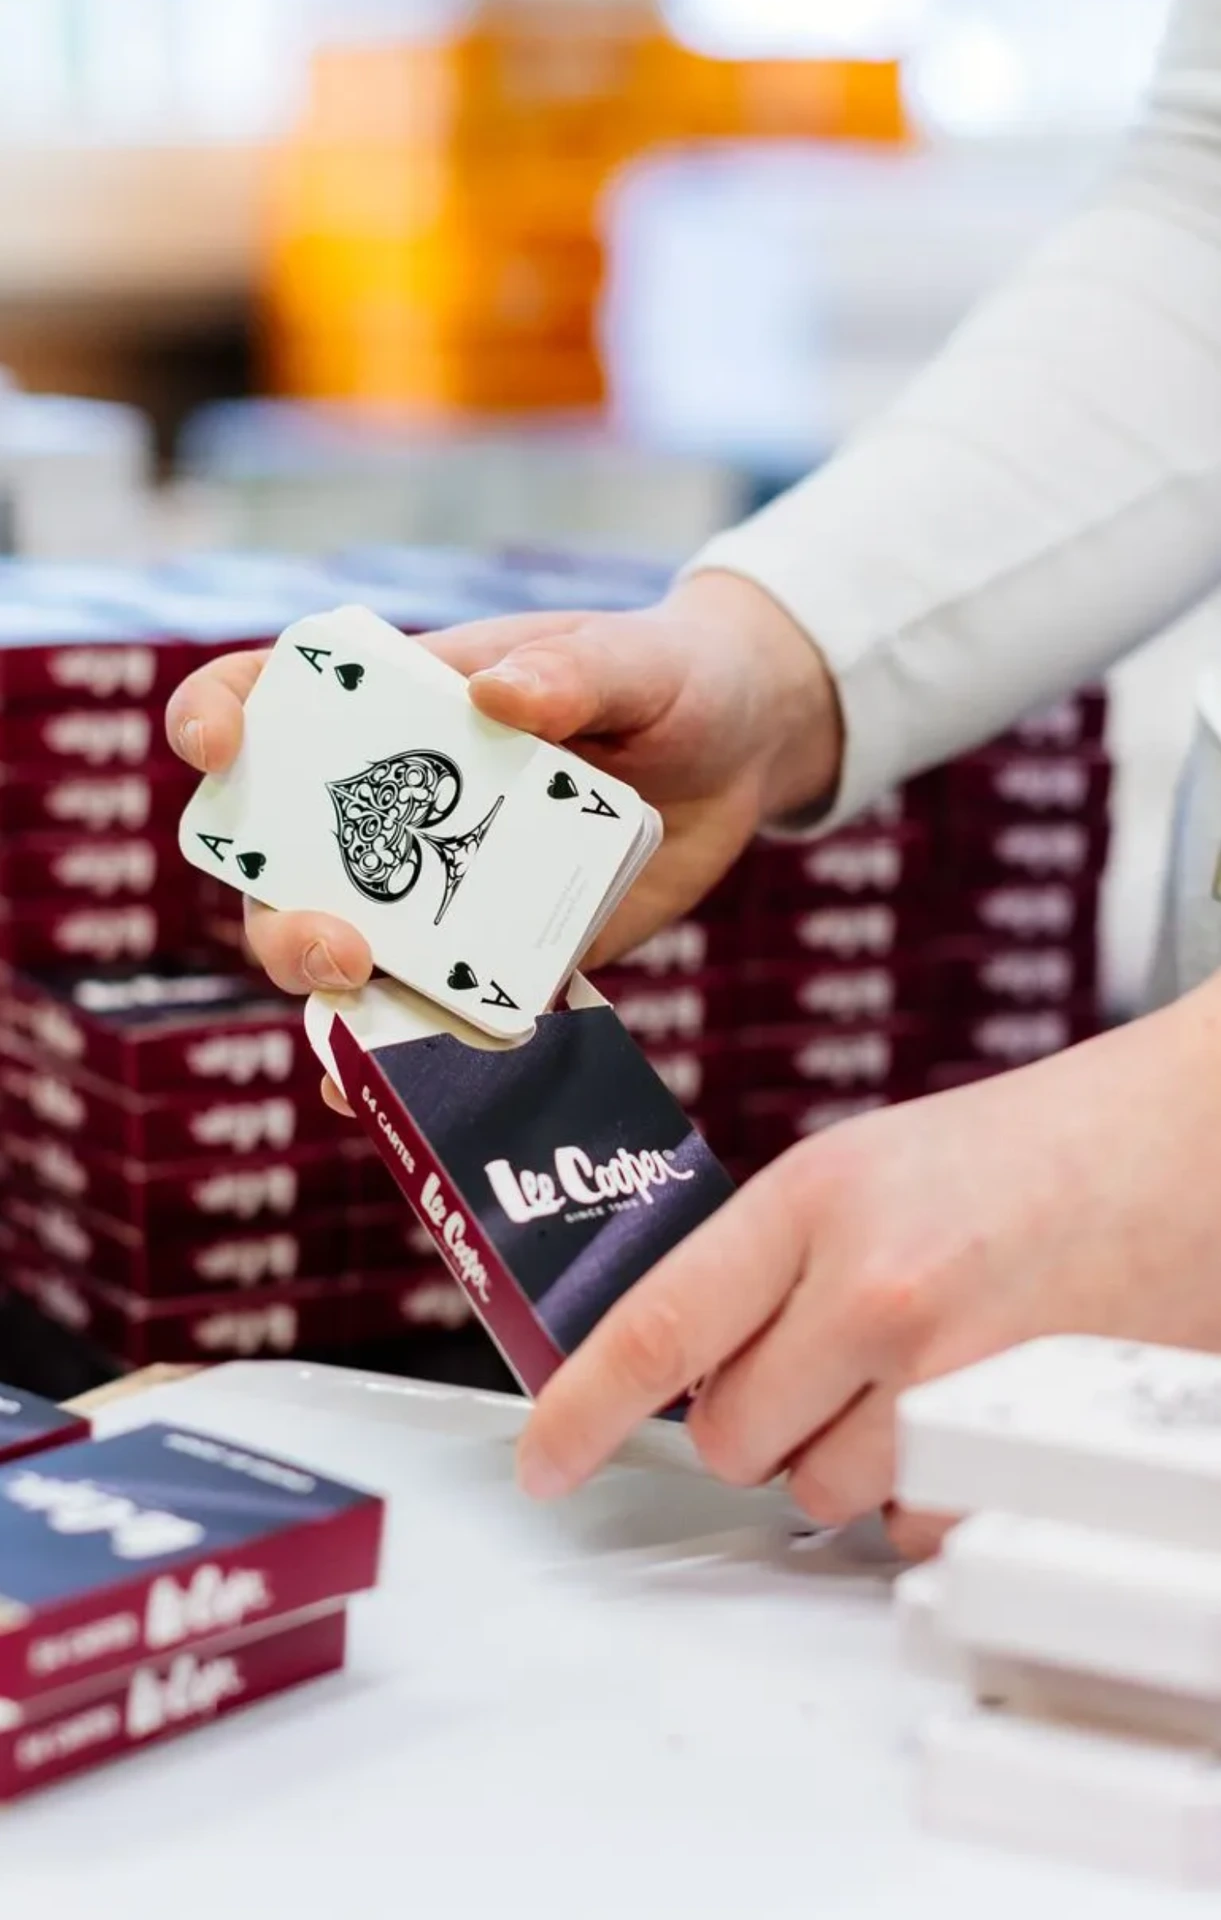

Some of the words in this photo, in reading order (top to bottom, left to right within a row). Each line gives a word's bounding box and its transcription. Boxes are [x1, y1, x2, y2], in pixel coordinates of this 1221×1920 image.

[294, 645, 332, 674] A
[580, 788, 621, 819] A
[196, 832, 235, 863] A
[480, 979, 521, 1011] A
[377, 1111, 416, 1174] CARTES
[484, 1158, 566, 1224] Lee
